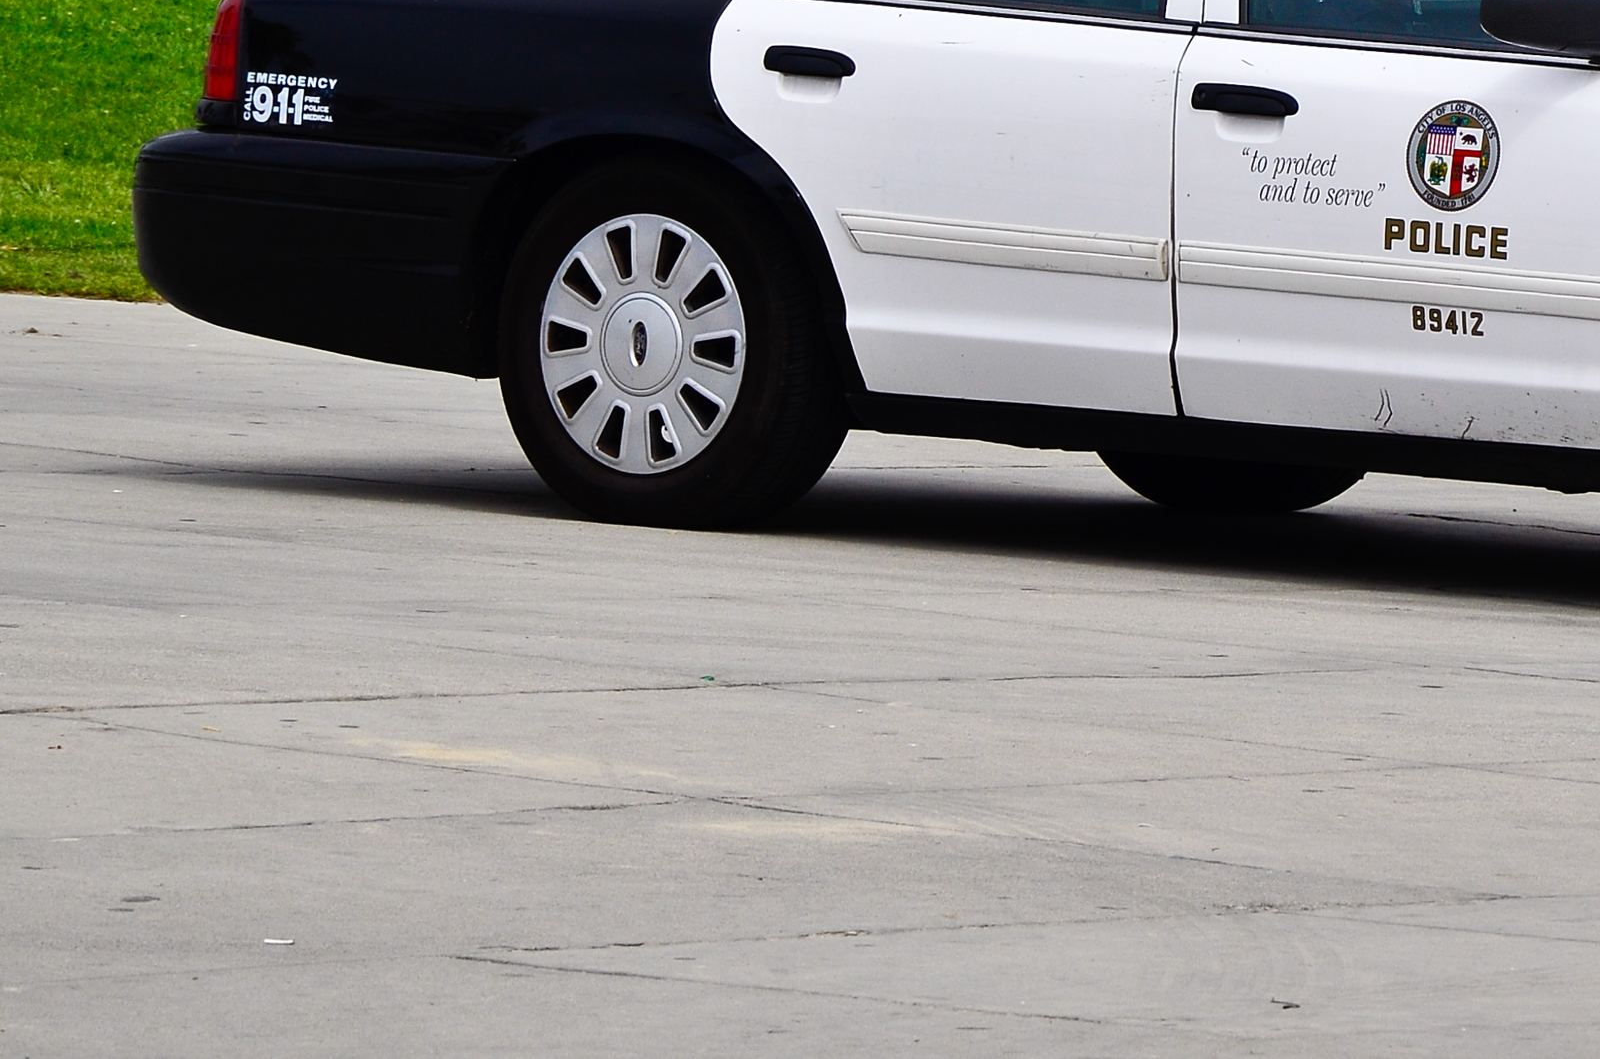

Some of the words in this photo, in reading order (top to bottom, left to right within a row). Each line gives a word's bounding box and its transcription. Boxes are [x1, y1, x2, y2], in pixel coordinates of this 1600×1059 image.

[246, 71, 338, 90] EMERGENCY
[243, 87, 254, 121] CALL
[303, 104, 329, 113] POLICE
[1417, 113, 1435, 134] CITY
[1435, 107, 1447, 117] OF
[1450, 103, 1467, 112] LOS
[1467, 107, 1496, 140] ANGELES
[1272, 153, 1338, 180] protect
[1258, 178, 1298, 203] and
[1302, 181, 1321, 205] to
[1423, 190, 1456, 207] FOUNDED
[1460, 194, 1476, 206] 1781
[1384, 217, 1509, 260] POLICE
[1411, 305, 1485, 337] 89412
